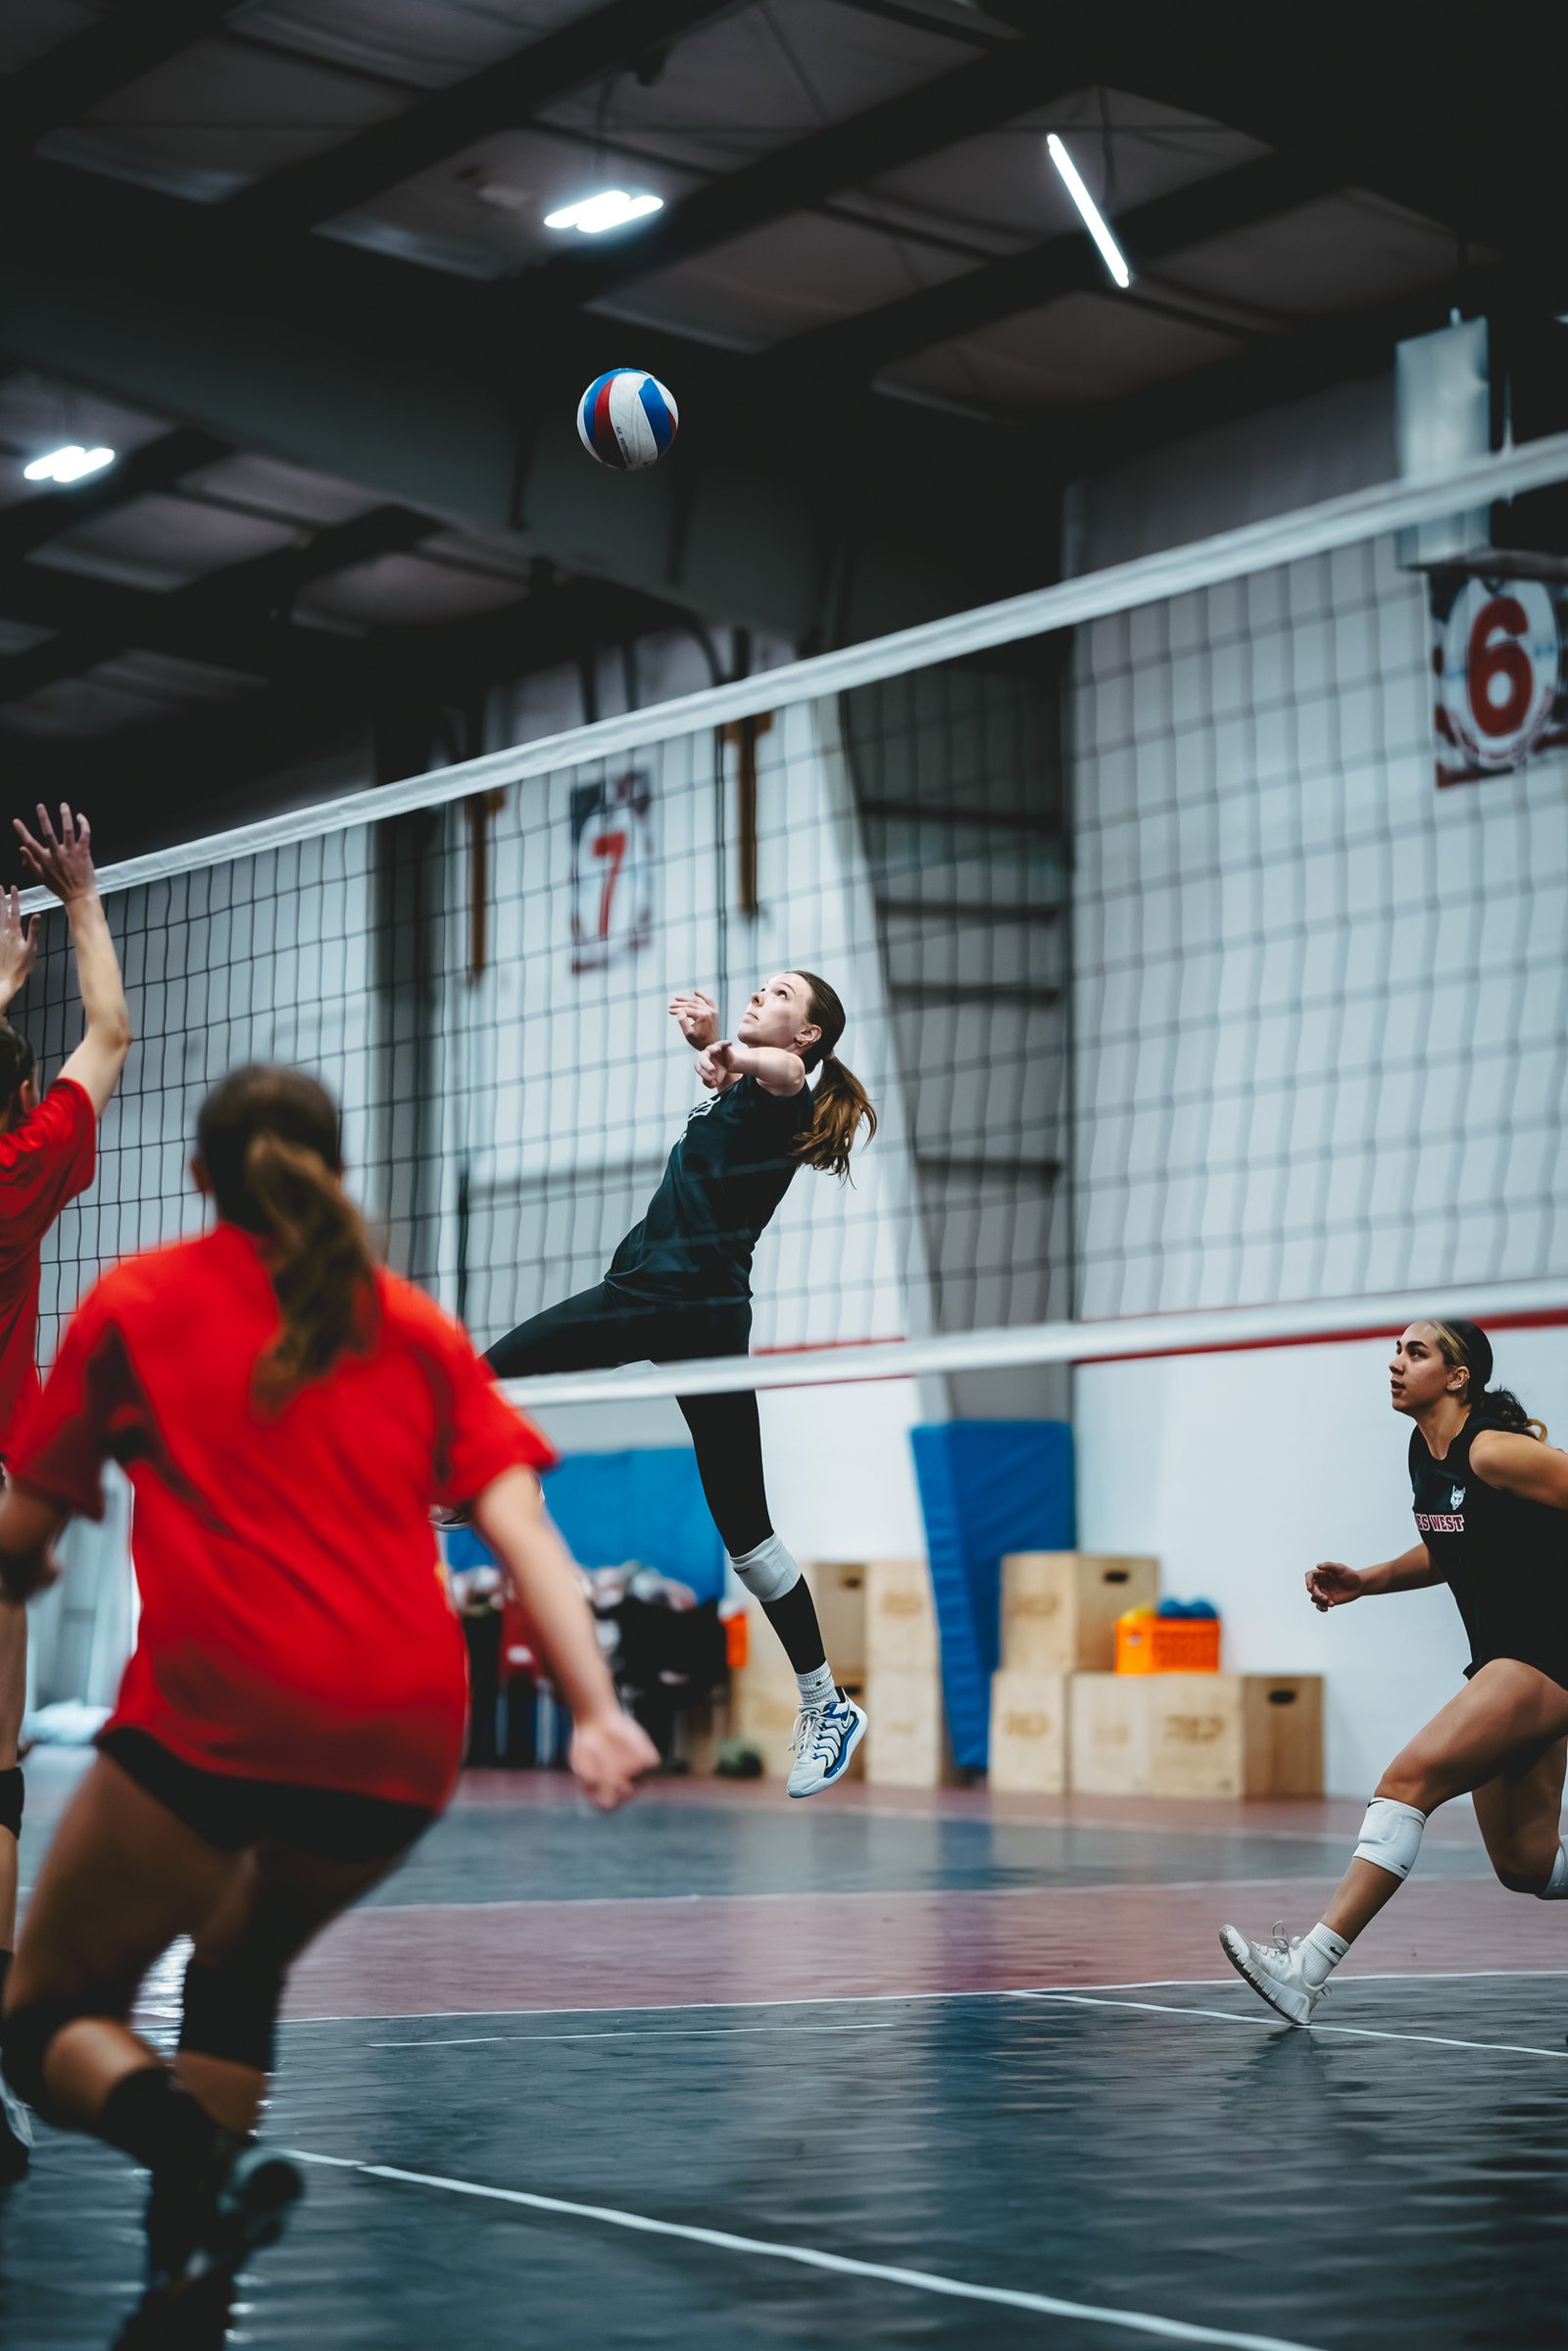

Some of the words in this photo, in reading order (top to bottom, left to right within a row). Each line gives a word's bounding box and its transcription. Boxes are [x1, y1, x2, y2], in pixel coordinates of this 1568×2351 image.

[1467, 596, 1534, 738] 6
[593, 830, 627, 941] 7
[1430, 1514, 1465, 1532] WEST
